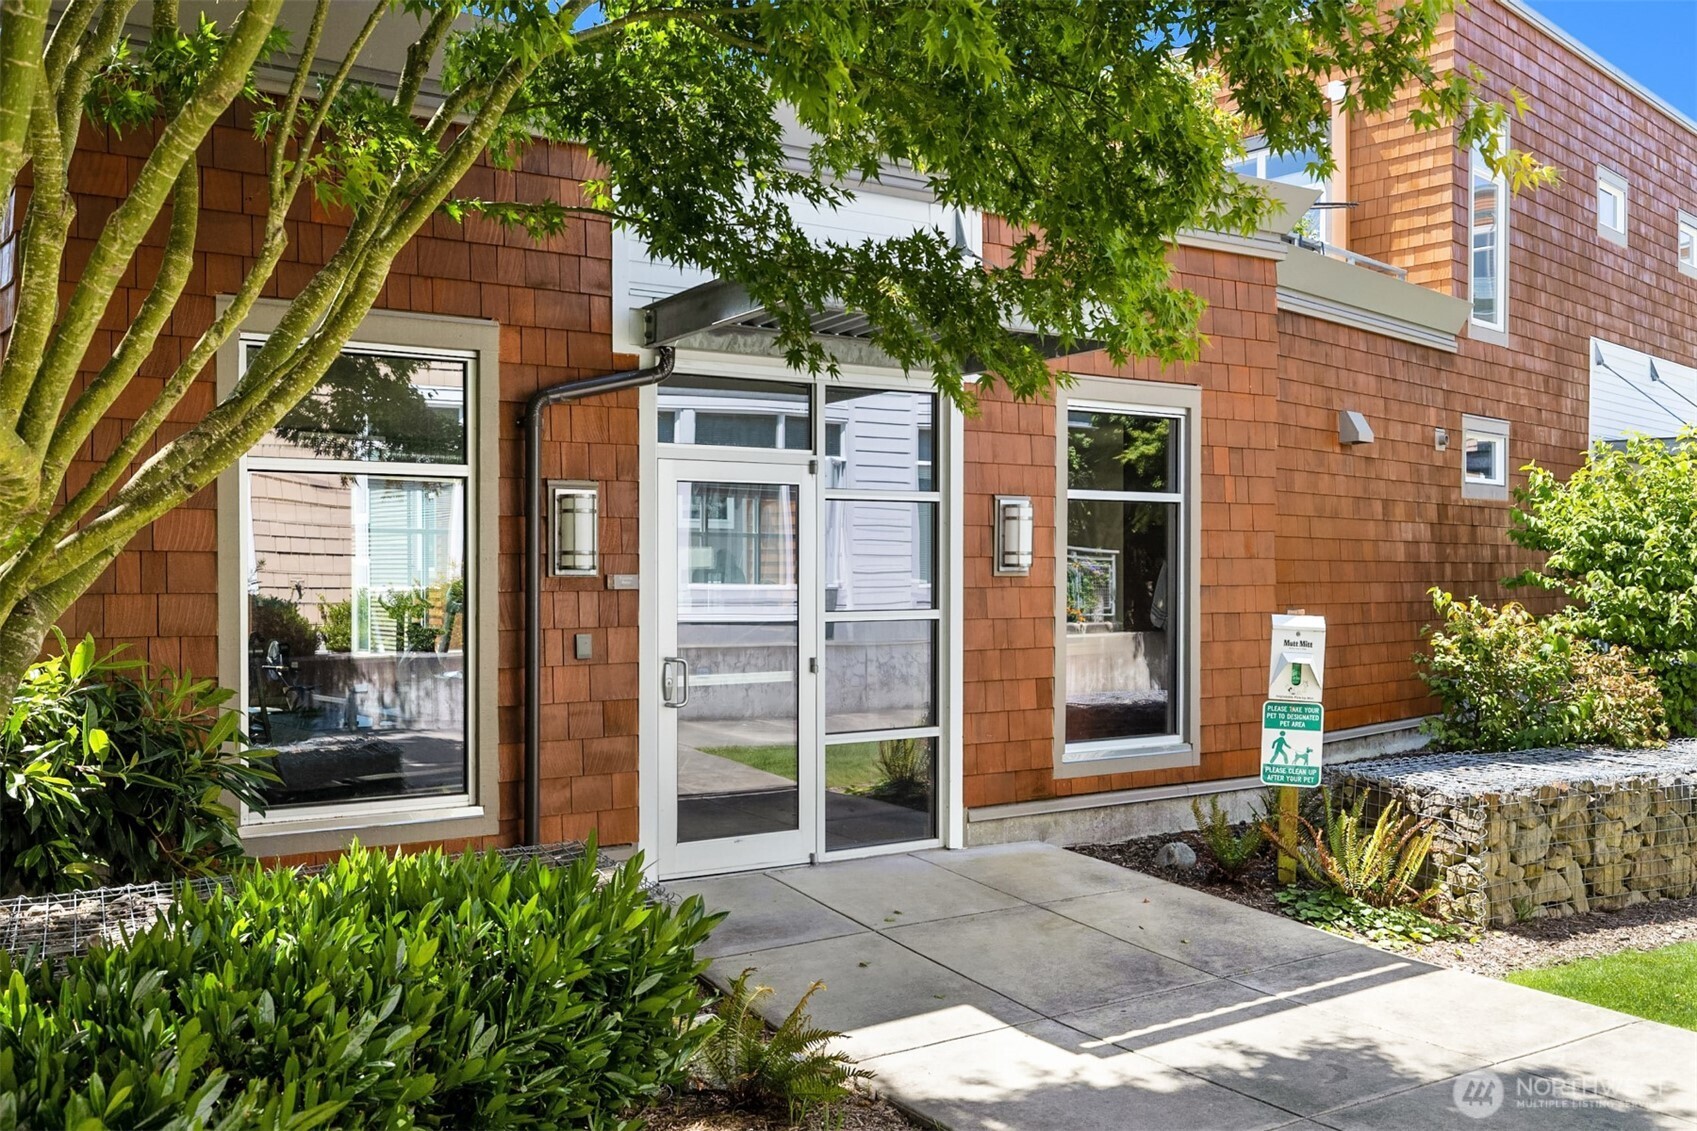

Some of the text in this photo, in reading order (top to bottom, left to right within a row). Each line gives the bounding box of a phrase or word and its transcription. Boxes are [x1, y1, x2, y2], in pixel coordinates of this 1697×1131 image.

[1283, 639, 1313, 648] Mutt Mitt
[1286, 713, 1320, 721] DESIGNATED
[1265, 766, 1286, 774] PLEASE
